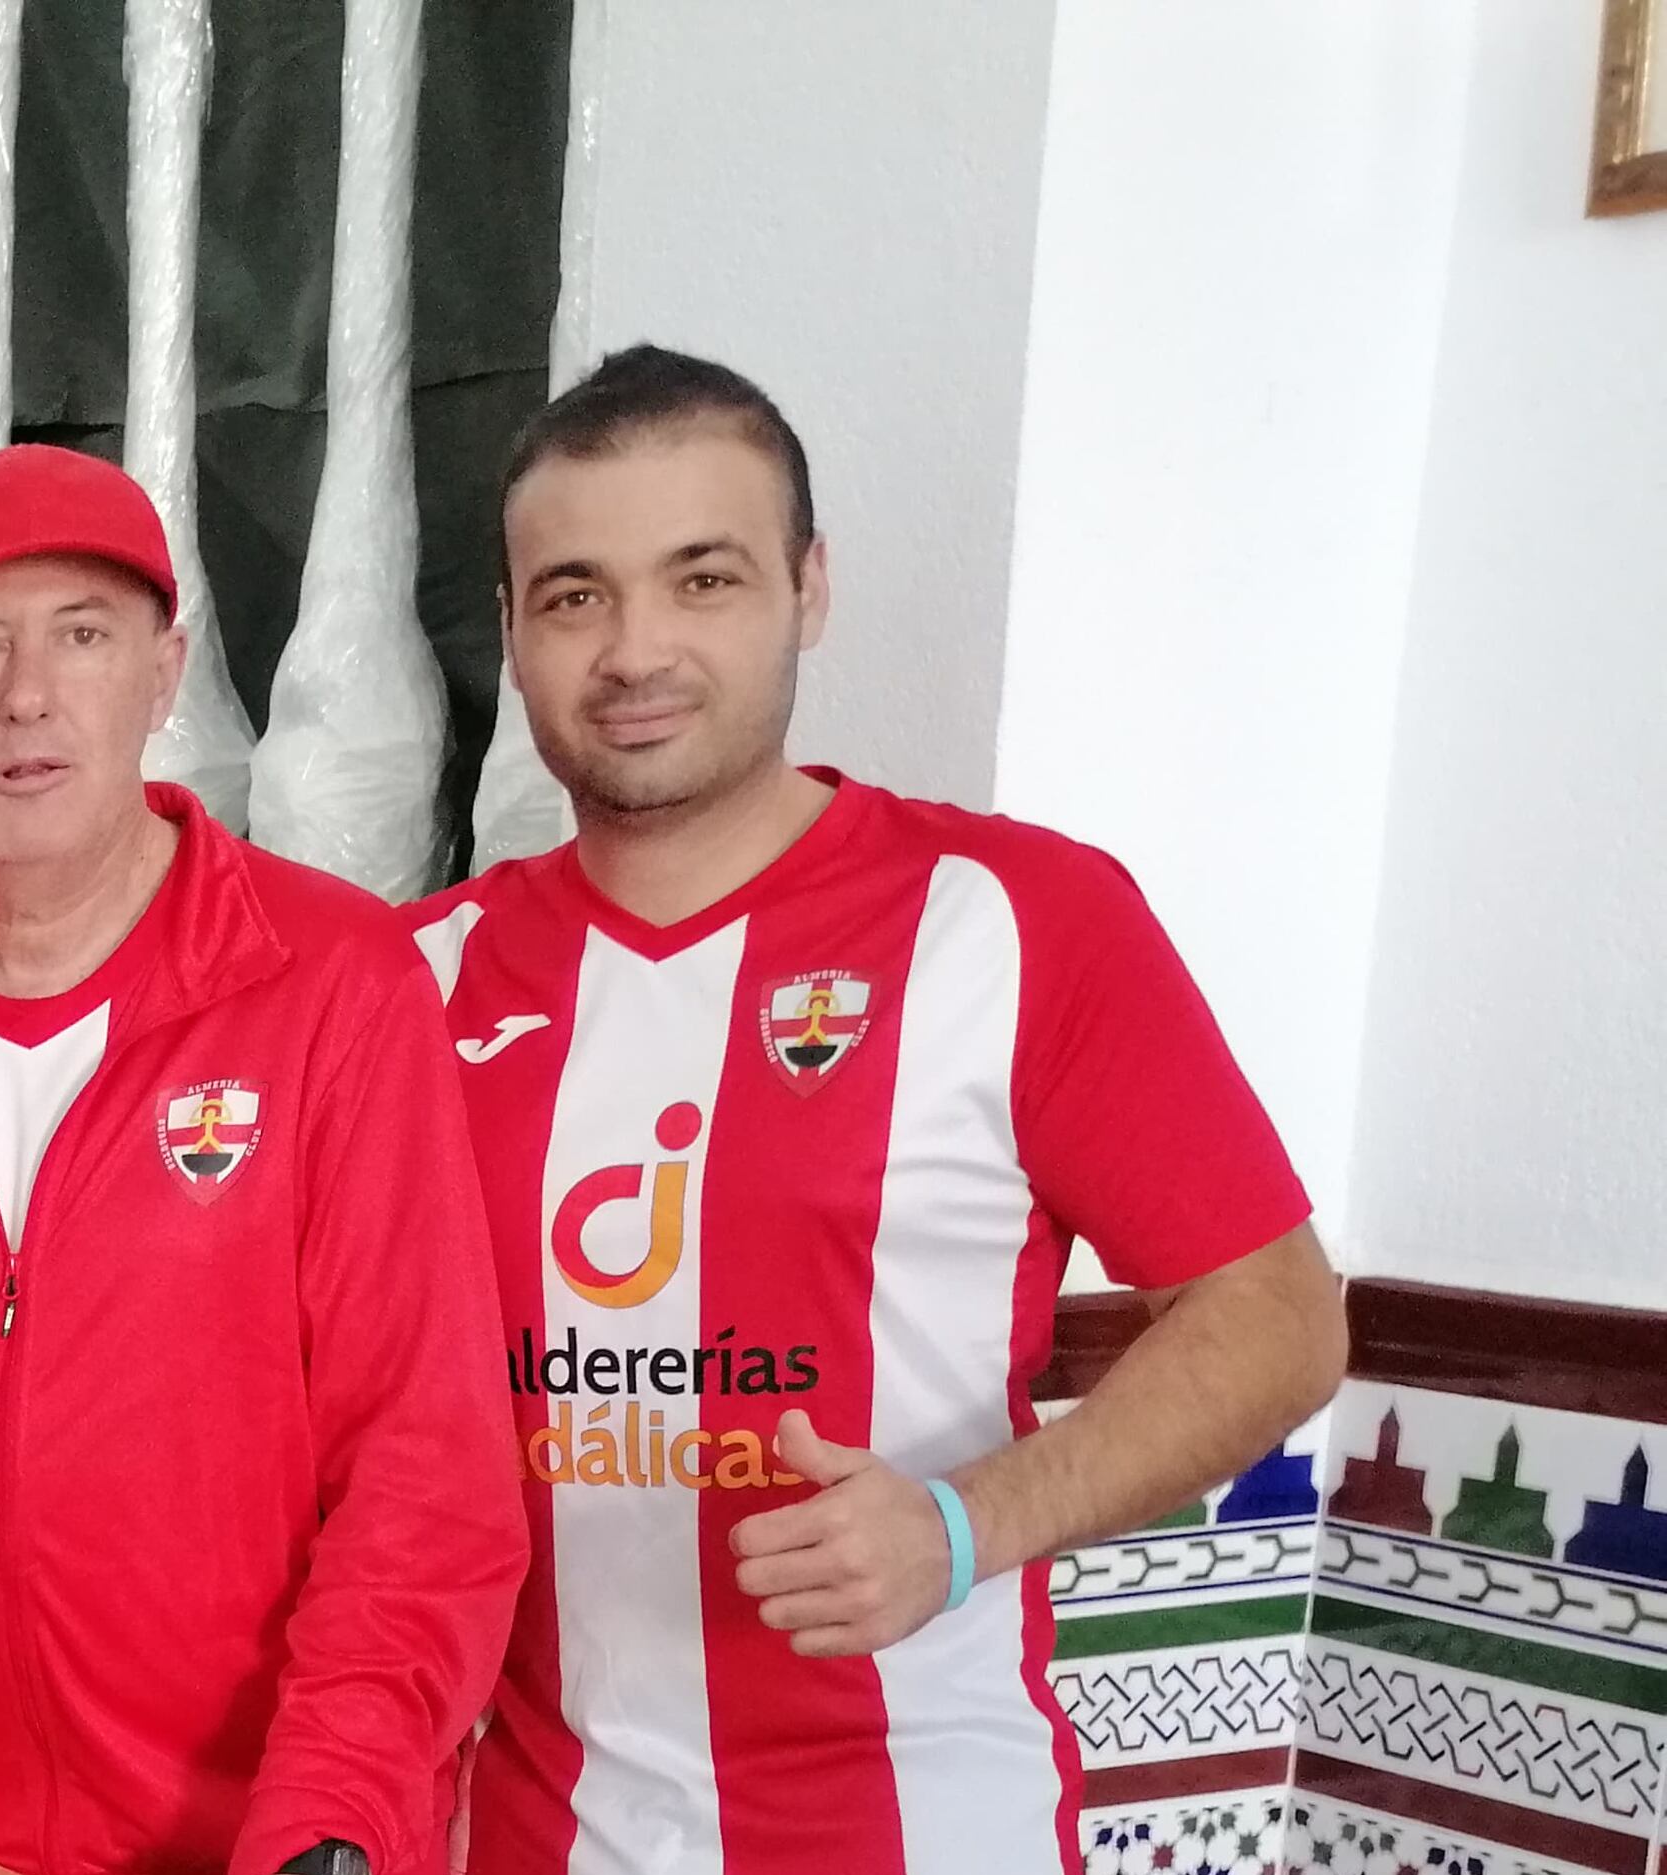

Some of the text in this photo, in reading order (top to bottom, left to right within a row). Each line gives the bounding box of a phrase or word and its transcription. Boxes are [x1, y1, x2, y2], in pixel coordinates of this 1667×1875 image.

[793, 969, 851, 984] ALMERIA
[187, 1079, 240, 1095] ALMERIA
[509, 1325, 820, 1396] ldererías
[522, 1400, 807, 1489] dálica
